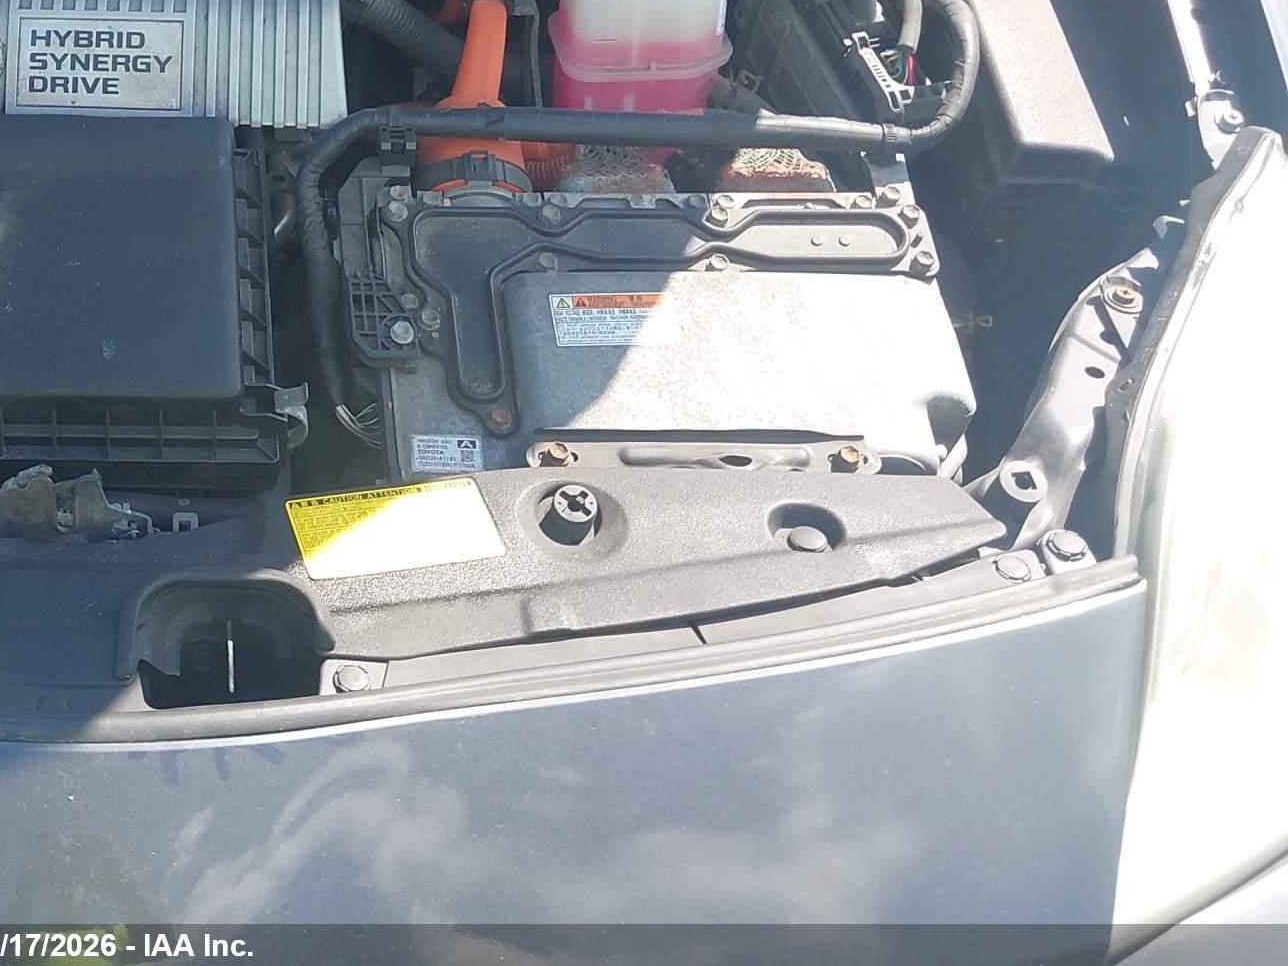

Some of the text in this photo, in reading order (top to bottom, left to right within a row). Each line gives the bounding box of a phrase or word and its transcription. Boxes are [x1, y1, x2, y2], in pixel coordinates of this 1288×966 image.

[30, 29, 146, 50] HYBRID
[29, 52, 174, 73] SYNERGY
[28, 75, 120, 95] DRIVE
[322, 494, 364, 505] CAUTION
[367, 486, 418, 500] ATTENTION
